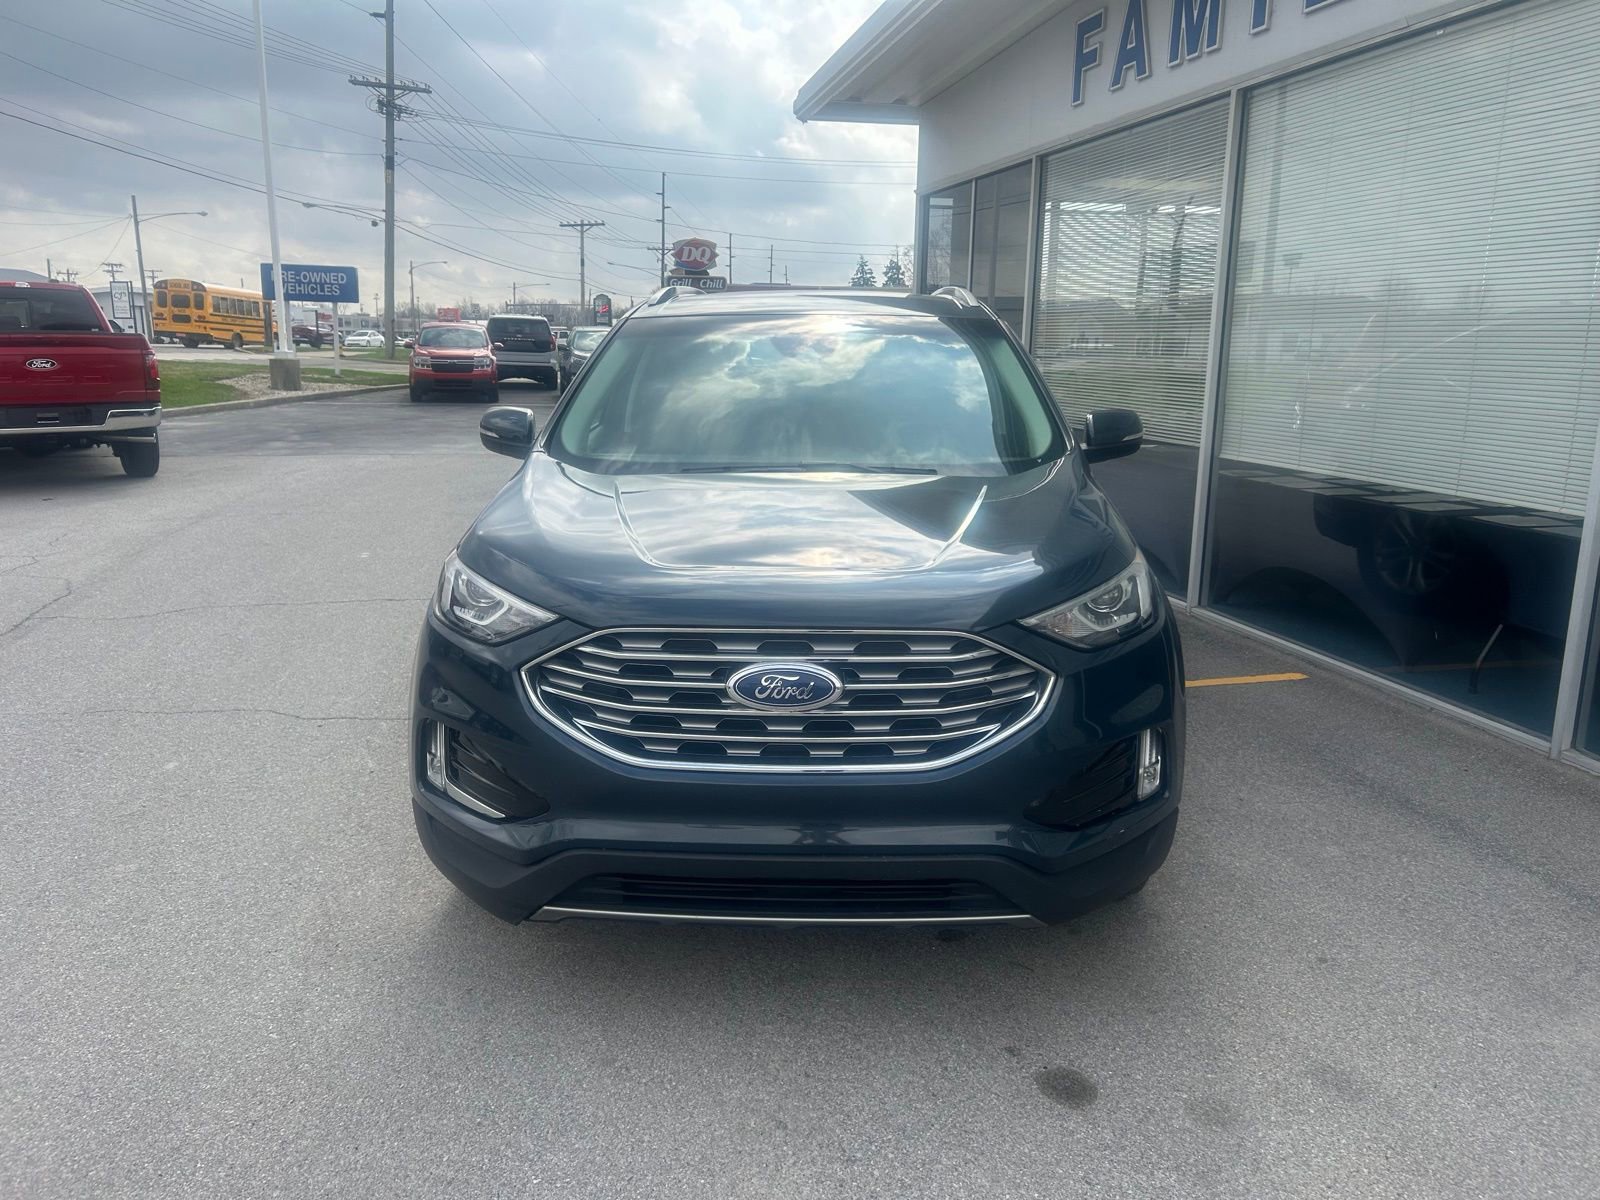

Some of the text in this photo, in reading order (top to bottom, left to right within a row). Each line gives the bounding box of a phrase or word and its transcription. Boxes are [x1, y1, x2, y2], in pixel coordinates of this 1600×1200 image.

[1071, 0, 1342, 107] FAM
[680, 246, 711, 264] DQ
[270, 270, 347, 284] RE-OWNED
[669, 278, 723, 289] Grill Chill
[31, 360, 52, 368] Ford
[755, 674, 815, 699] Ford
